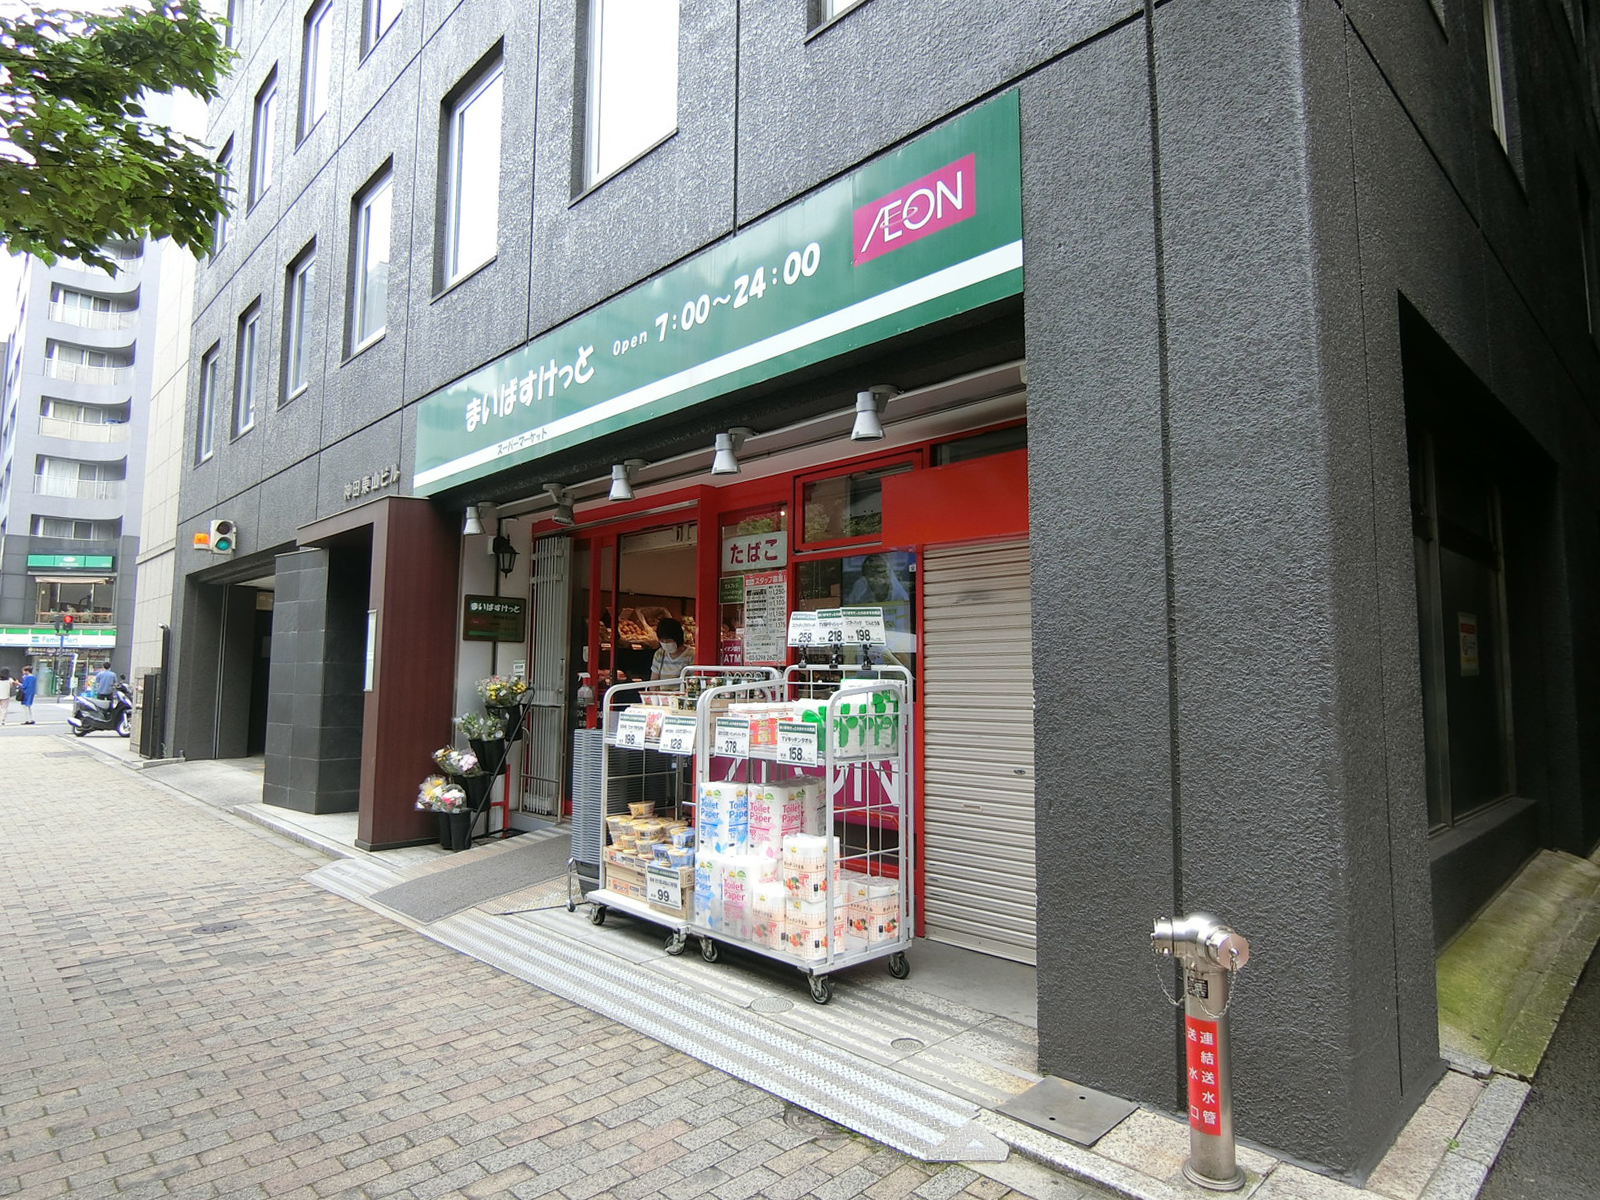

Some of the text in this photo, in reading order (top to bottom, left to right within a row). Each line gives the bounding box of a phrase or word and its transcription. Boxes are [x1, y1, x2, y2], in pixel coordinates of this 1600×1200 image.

[612, 331, 648, 356] Open
[465, 344, 595, 433] まいばすけっと
[496, 427, 548, 456] スーパーマーケット
[730, 538, 778, 565] たばこ
[470, 602, 521, 613] まいばすけっと
[798, 632, 812, 643] 258
[828, 630, 843, 642] 218
[855, 629, 871, 642] 198
[723, 653, 742, 663] ATM
[624, 734, 636, 745] 198
[670, 738, 683, 750] 128
[724, 740, 738, 753] 378
[788, 746, 803, 761] 158
[750, 801, 771, 814] Toilet
[750, 811, 772, 823] Paper
[724, 878, 744, 891] Toilet
[657, 888, 670, 902] 99
[724, 888, 746, 902] Paper
[1187, 1025, 1199, 1119] 送水口
[1199, 1031, 1216, 1125] 連結送水管
